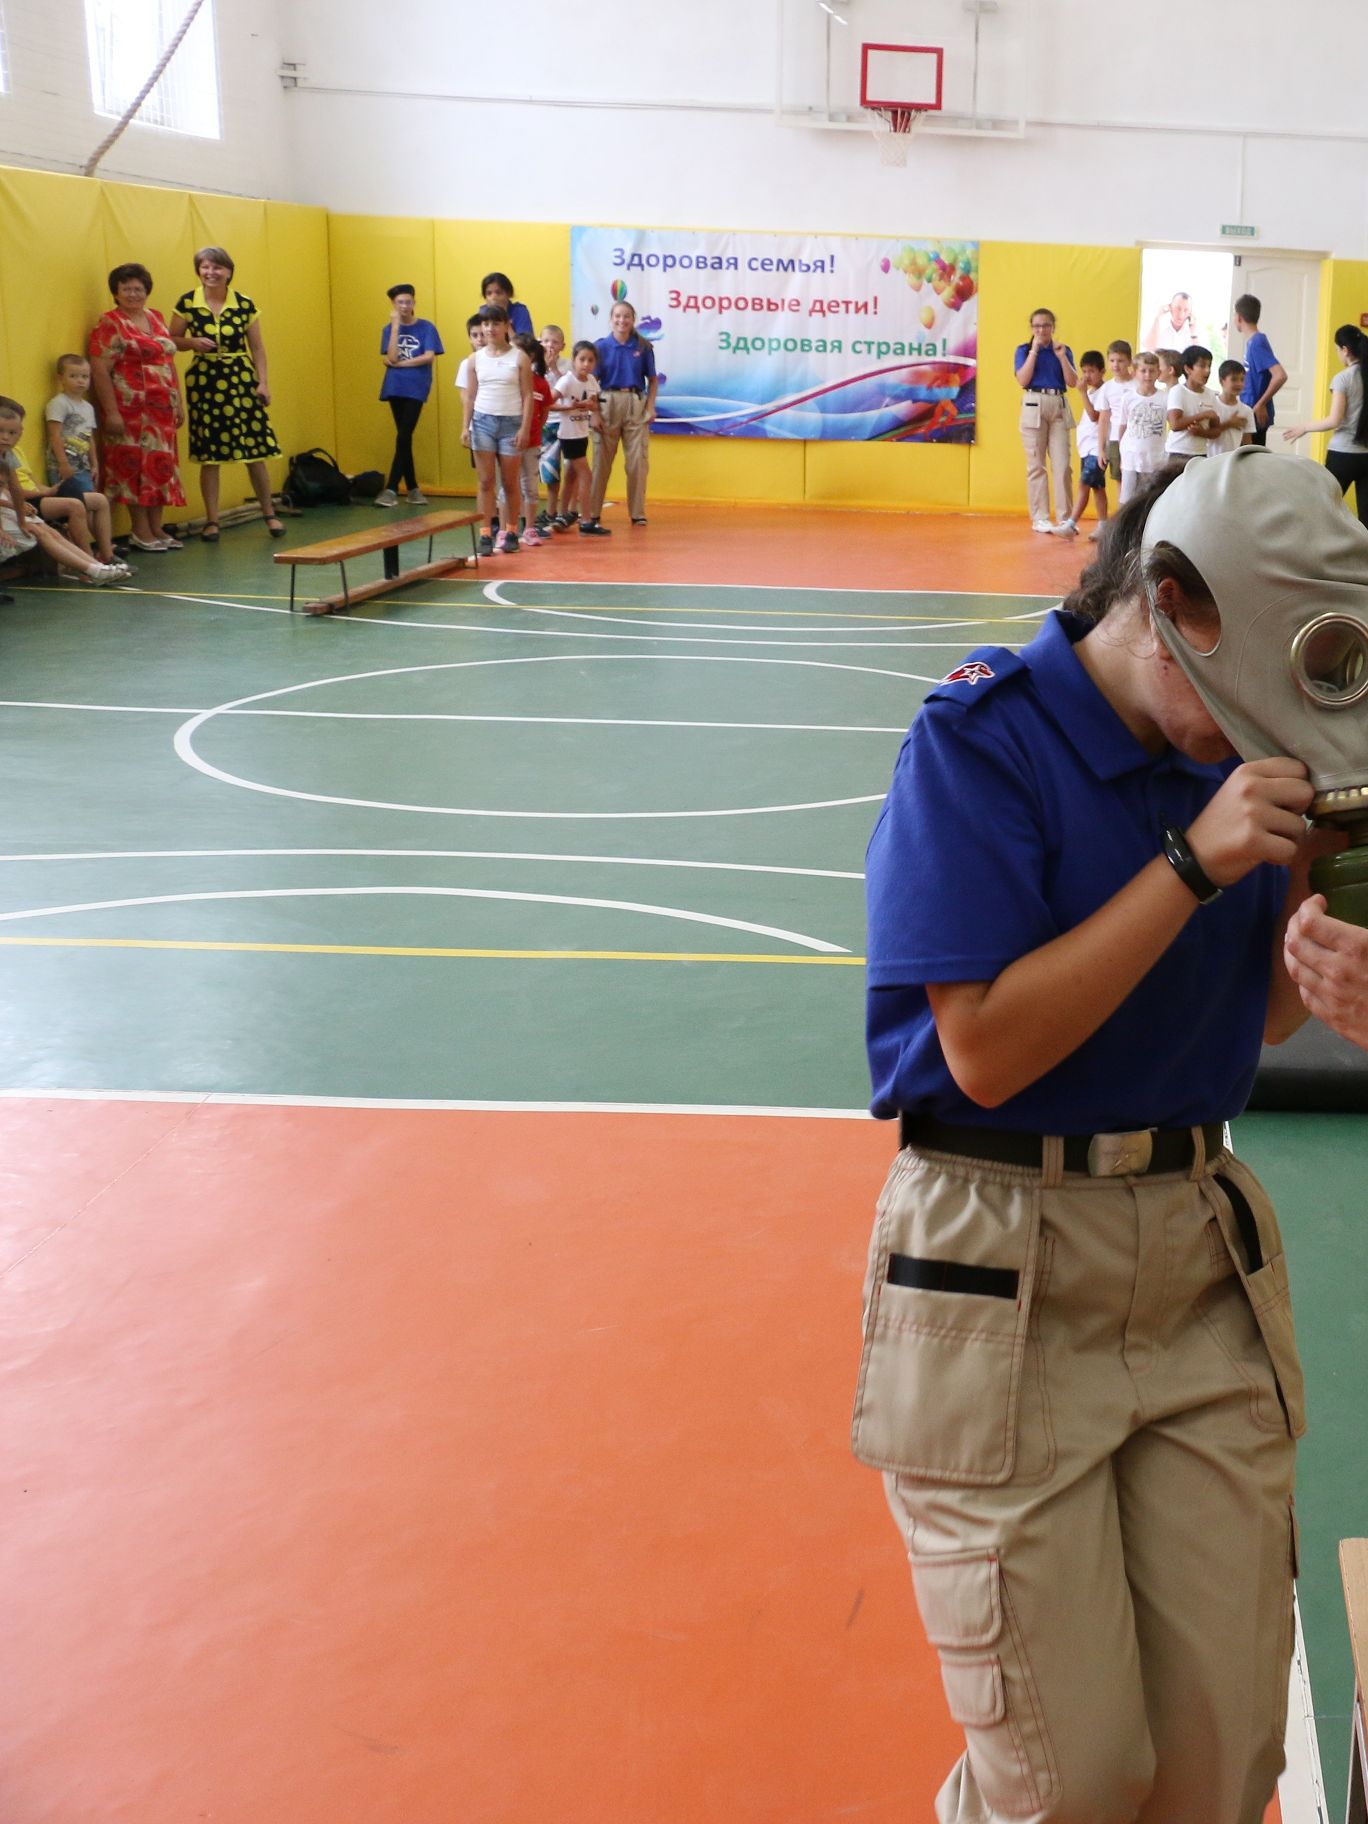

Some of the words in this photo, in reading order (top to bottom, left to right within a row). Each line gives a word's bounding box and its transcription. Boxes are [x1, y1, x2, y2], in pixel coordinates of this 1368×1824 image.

[612, 248, 739, 271] Здоровая
[747, 254, 835, 273] семья!
[667, 290, 801, 314] Здоровые
[808, 296, 879, 317] дети!
[717, 331, 843, 354] Здоровая
[850, 337, 948, 360] страна!
